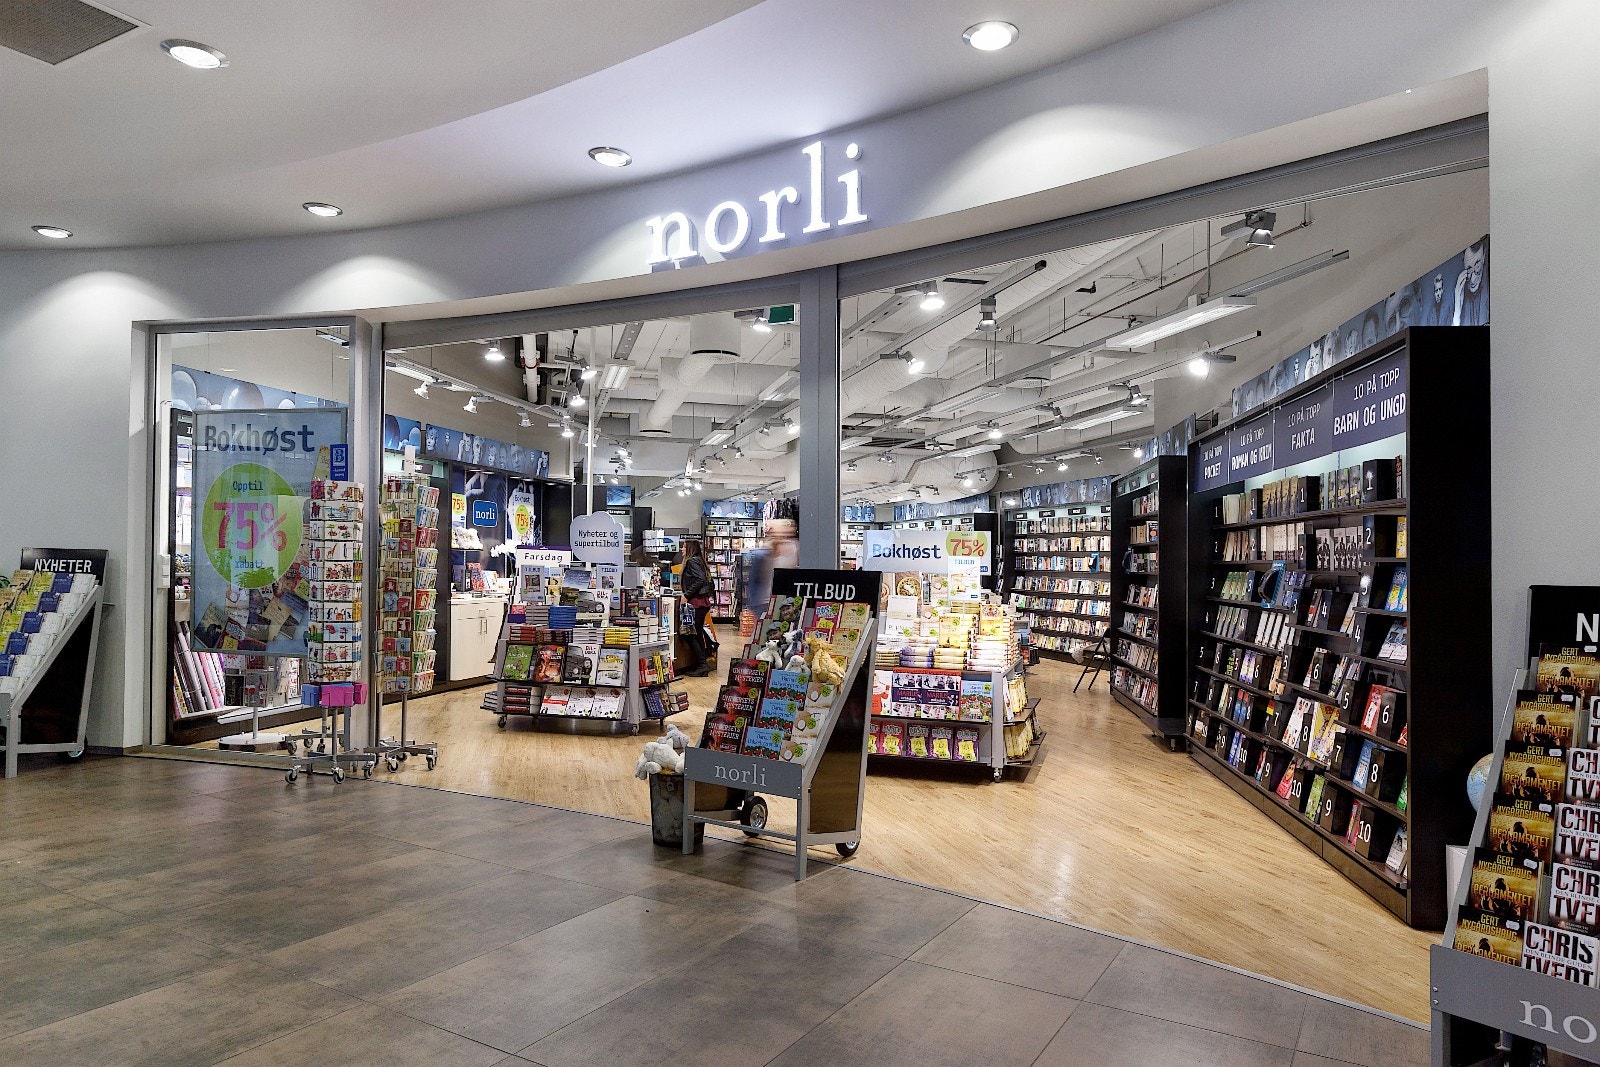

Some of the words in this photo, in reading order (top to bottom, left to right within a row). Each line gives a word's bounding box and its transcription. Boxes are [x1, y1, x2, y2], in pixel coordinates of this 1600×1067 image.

[646, 141, 868, 264] norli
[1353, 383, 1364, 401] 10
[1366, 373, 1377, 395] PÅ
[1379, 367, 1400, 390] TOPP
[1287, 413, 1296, 428] 10
[1296, 406, 1305, 425] PÅ
[1306, 402, 1321, 421] TOPP
[1333, 409, 1359, 436] BARN
[1363, 404, 1376, 427] OG
[1380, 392, 1406, 421] UNGD
[204, 423, 316, 456] Bokhøst
[1291, 427, 1315, 451] FAKTA
[1250, 449, 1258, 465] OG
[232, 480, 264, 492] Opptil
[1300, 487, 1305, 503] 1
[452, 498, 465, 511] 75%
[475, 508, 495, 520] norli
[516, 513, 529, 527] 75%
[213, 502, 287, 551] 75%
[578, 529, 608, 538] Nyheter
[609, 531, 619, 539] og
[574, 539, 620, 548] supertilbud
[1365, 527, 1372, 545] 2
[872, 543, 942, 560] Bokhøst
[950, 538, 985, 557] 75%
[34, 558, 92, 573] NYHETER
[524, 553, 563, 562] Farsdag
[793, 582, 856, 601] TILBUD
[1292, 598, 1298, 614] 3
[1321, 601, 1328, 618] 4
[1354, 624, 1361, 643] 4
[1576, 612, 1600, 643] N
[1544, 653, 1596, 666] NYGÅRDSHAUG
[1561, 647, 1580, 656] GERT
[1282, 655, 1289, 670] 5
[1254, 664, 1260, 679] 6
[1313, 663, 1320, 680] 6
[1342, 691, 1350, 710] 5
[1537, 693, 1554, 703] GERT
[1382, 704, 1390, 724] 6
[1520, 701, 1571, 713] NYGÅRDSHAUG
[1274, 711, 1280, 727] 7
[1220, 735, 1226, 749] 9
[1302, 725, 1309, 742] 8
[1239, 747, 1248, 764] 10
[1334, 744, 1342, 763] 7
[1509, 751, 1562, 767] NYGÅRDSHAUG
[1526, 745, 1545, 756] GERT
[1264, 762, 1271, 777] 9
[1572, 750, 1600, 774] CH
[714, 763, 768, 787] norli
[1370, 763, 1379, 783] 8
[1291, 781, 1302, 799] 10
[1569, 776, 1600, 801] TV
[1325, 799, 1332, 817] 9
[1514, 799, 1532, 810] GERT
[1496, 804, 1550, 823] NYGÅRDSHAUG
[1357, 820, 1371, 843] 10
[1496, 854, 1515, 867] GERT
[1478, 860, 1533, 880] NYGÅRDSHAUG
[1555, 866, 1600, 898] CHR
[1555, 889, 1570, 897] DEN
[1553, 894, 1600, 926] TVE
[1480, 913, 1499, 927] GERT
[1461, 918, 1518, 943] NYGÅRDSHAUG
[1525, 924, 1594, 965] CHRIS
[1525, 948, 1538, 956] DEN
[1540, 952, 1566, 963] BLINDE
[1566, 959, 1594, 971] GUDEN
[1518, 999, 1599, 1045] no
